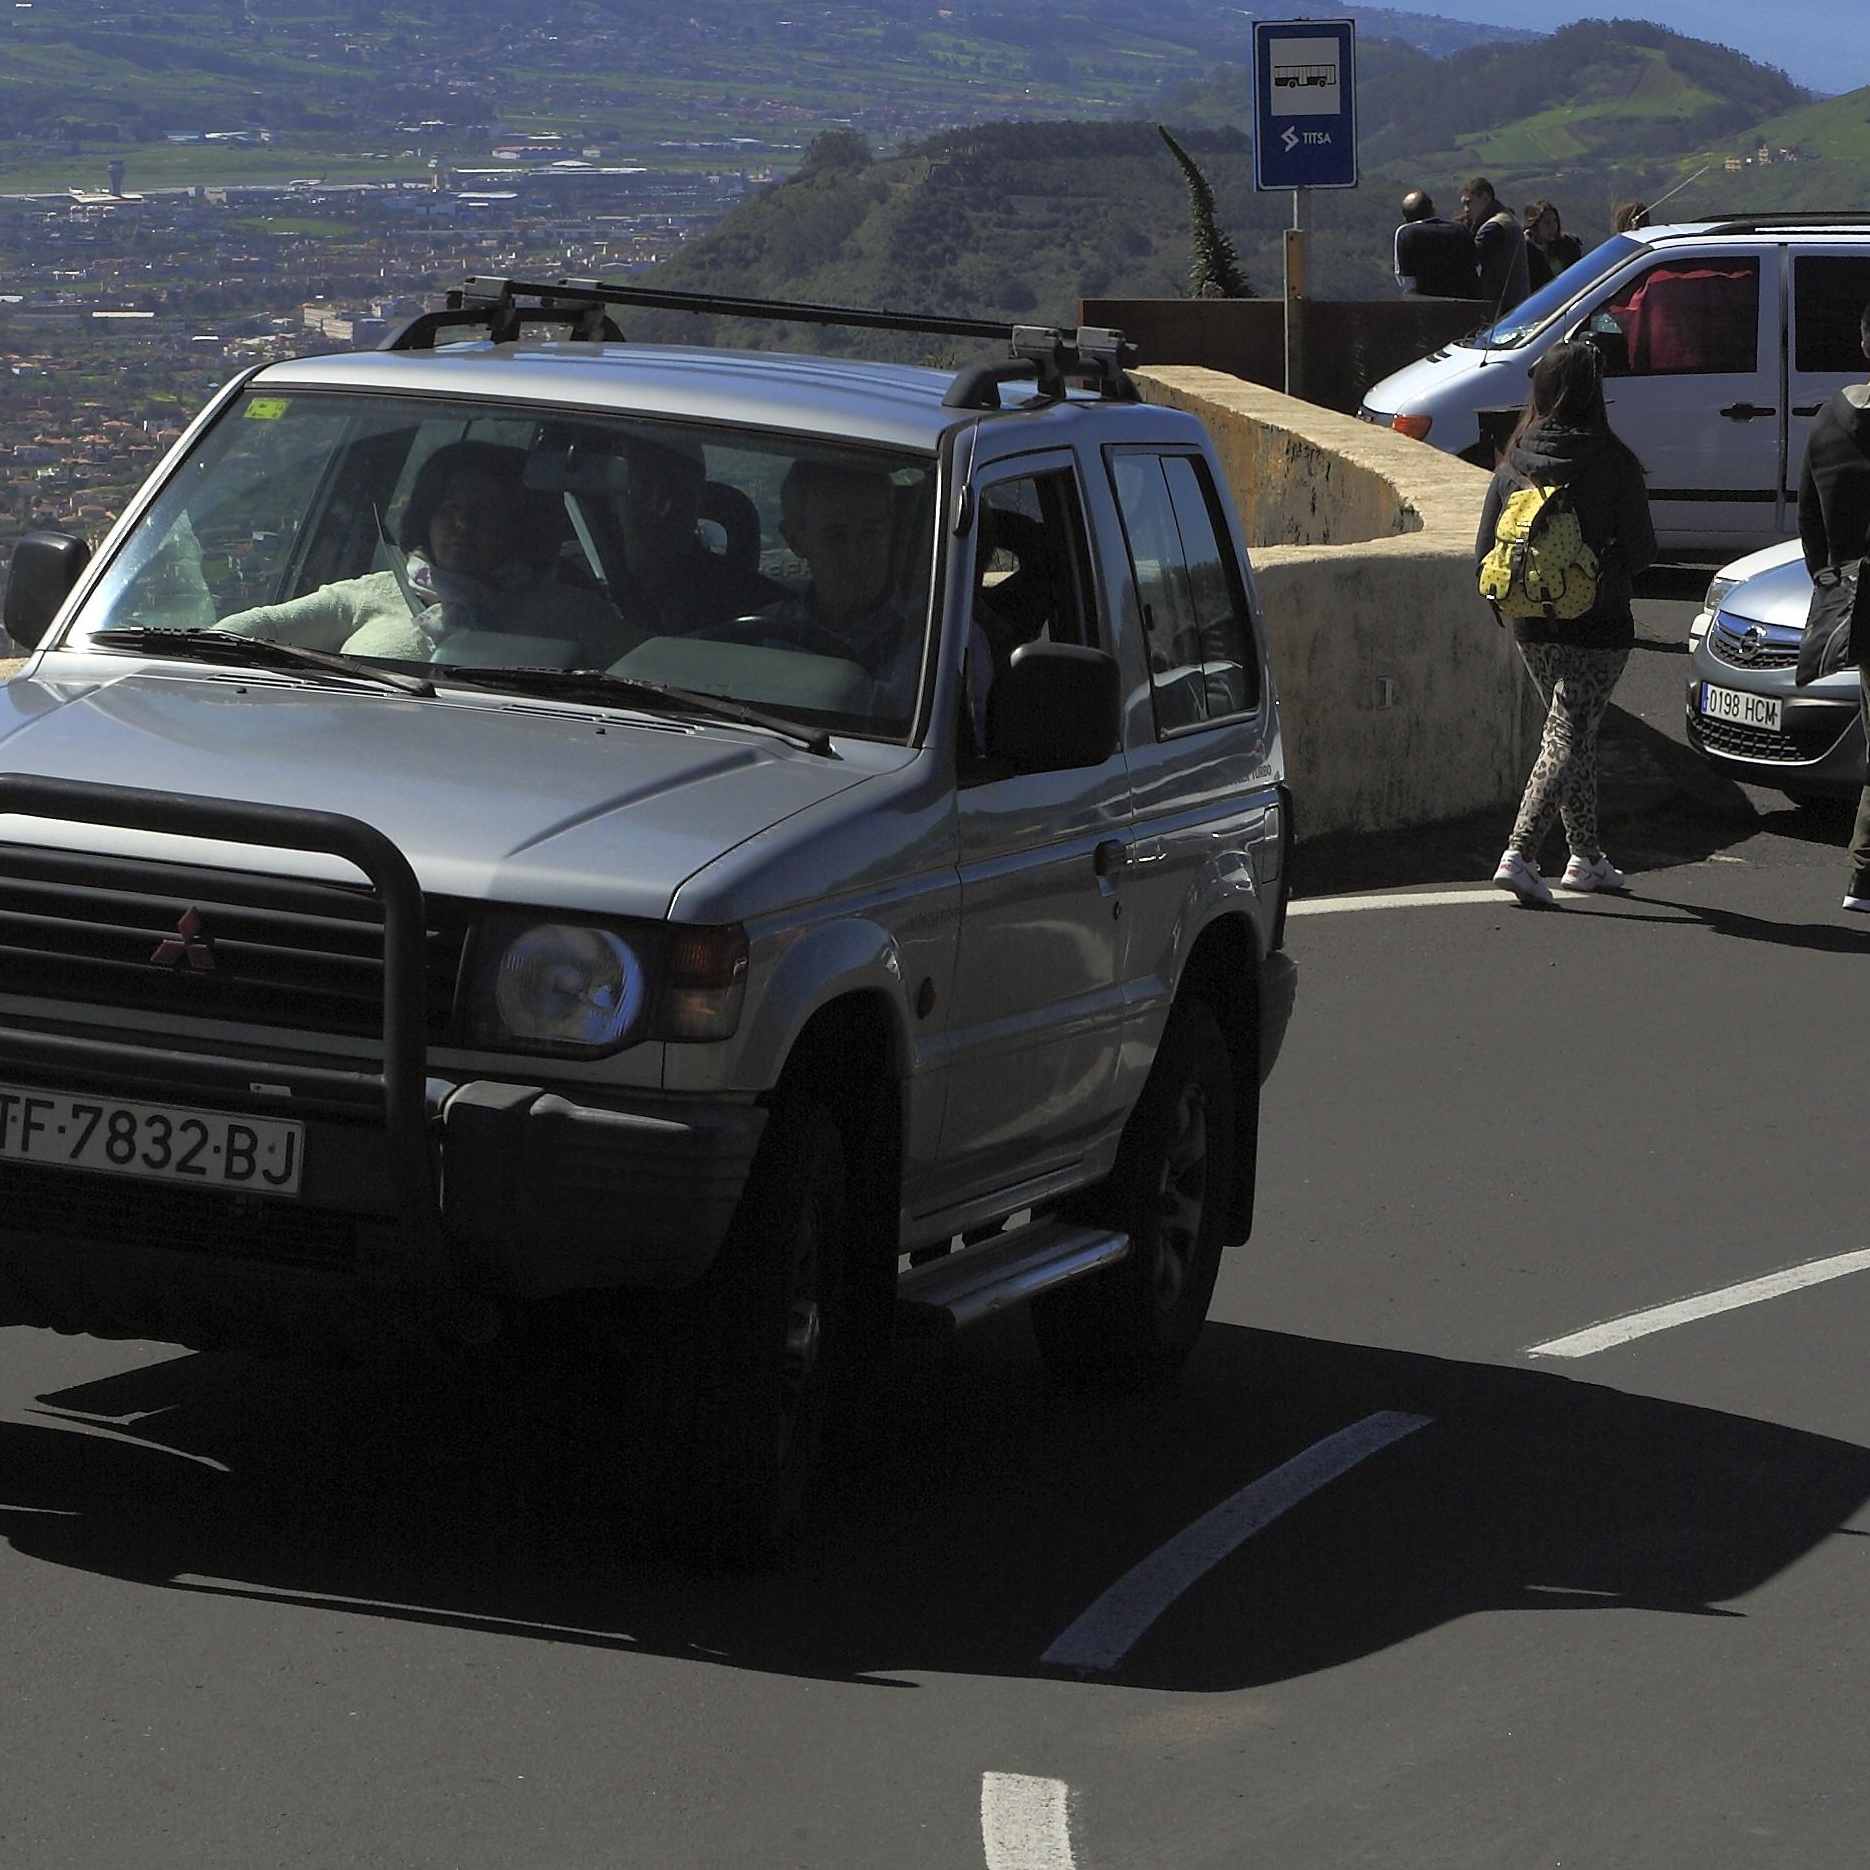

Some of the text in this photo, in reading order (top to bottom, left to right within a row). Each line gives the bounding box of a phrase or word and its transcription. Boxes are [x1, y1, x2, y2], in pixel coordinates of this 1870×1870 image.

[1302, 131, 1332, 144] TITSA
[1709, 689, 1776, 726] 0198 HCM
